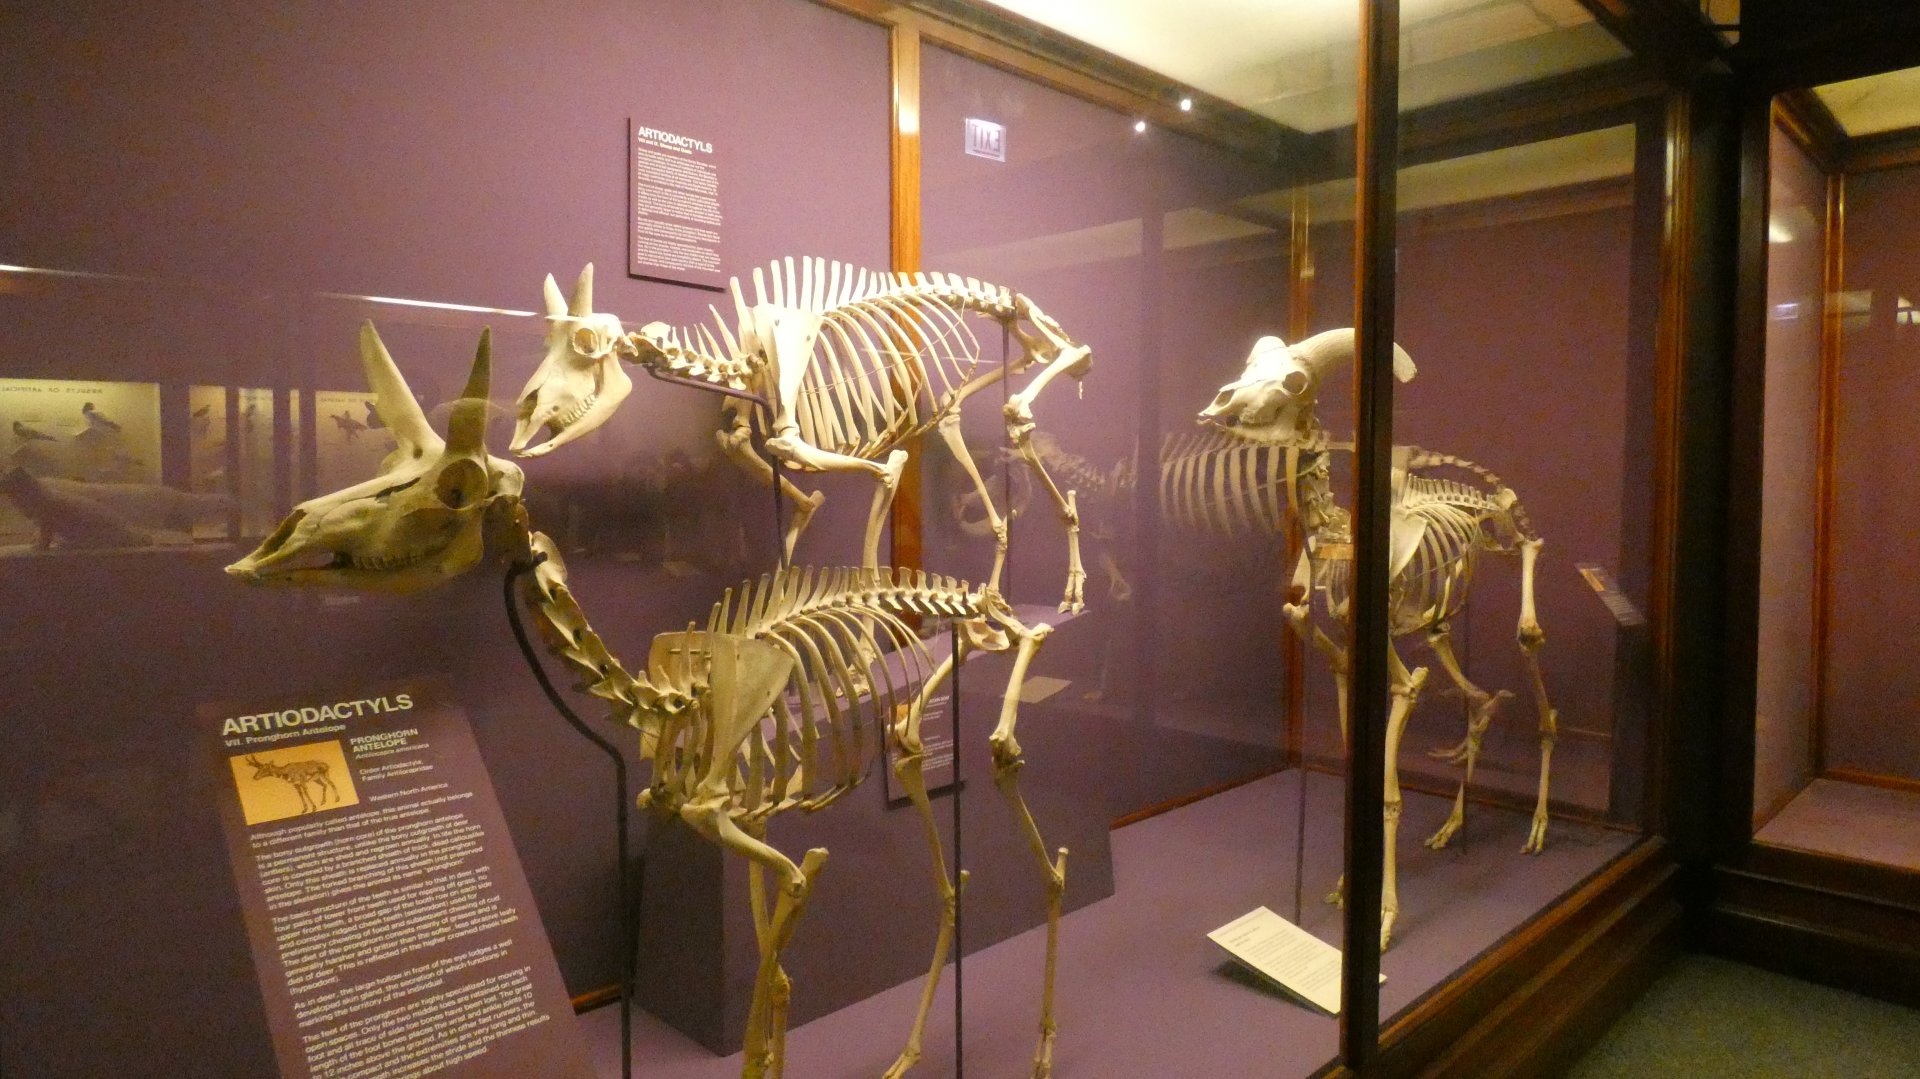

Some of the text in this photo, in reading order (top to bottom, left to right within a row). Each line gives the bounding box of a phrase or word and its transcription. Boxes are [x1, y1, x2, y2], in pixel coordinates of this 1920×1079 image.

[638, 126, 712, 154] ARTIODACTYLS
[222, 694, 414, 736] ARTIODACTYLS
[246, 730, 300, 744] Pronghorn
[302, 724, 346, 736] Antelope
[350, 728, 418, 745] PRONGHORN
[353, 738, 407, 752] ANTELOPE
[362, 773, 386, 781] Family
[369, 782, 448, 802] Western North America
